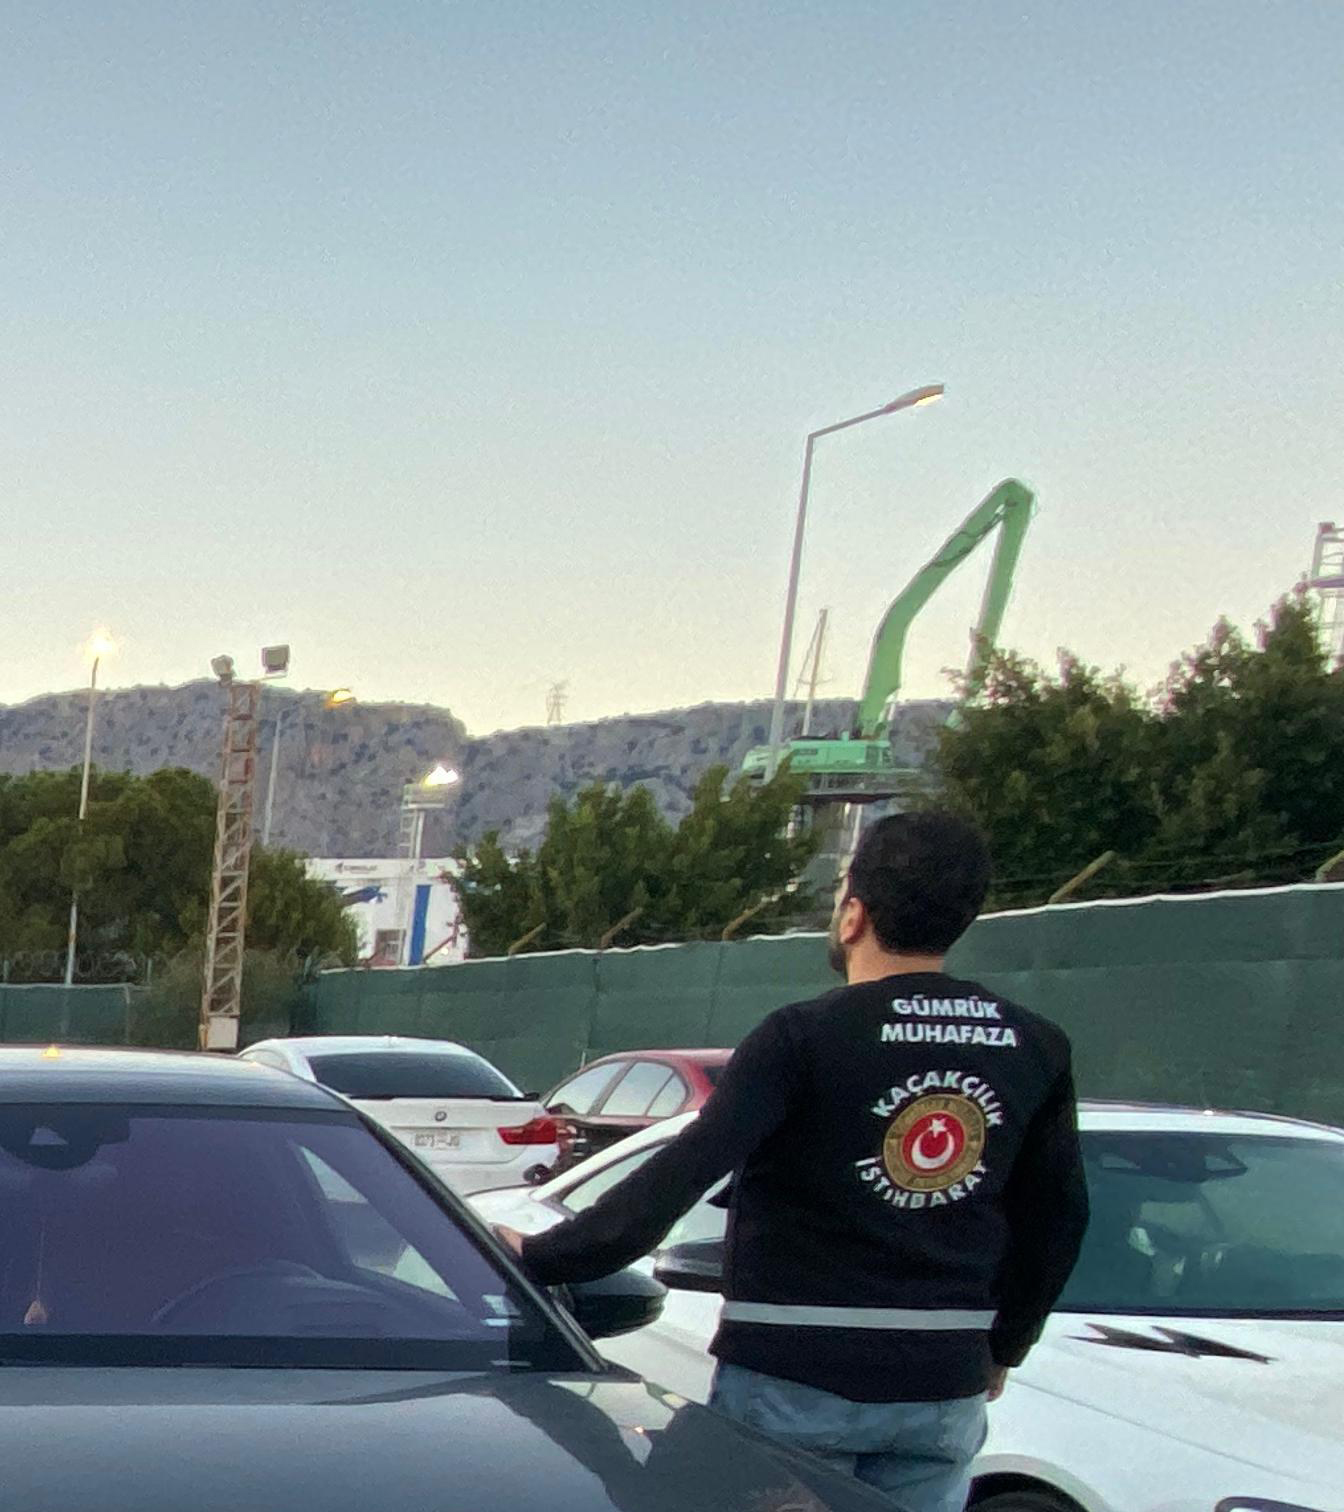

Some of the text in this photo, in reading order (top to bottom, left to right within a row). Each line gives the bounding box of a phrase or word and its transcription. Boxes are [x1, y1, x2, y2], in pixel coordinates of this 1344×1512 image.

[892, 994, 1002, 1019] GÜMRÜK
[881, 1023, 1018, 1048] MUHAFAZA
[870, 1070, 1004, 1128] KAÇAKÇILIK
